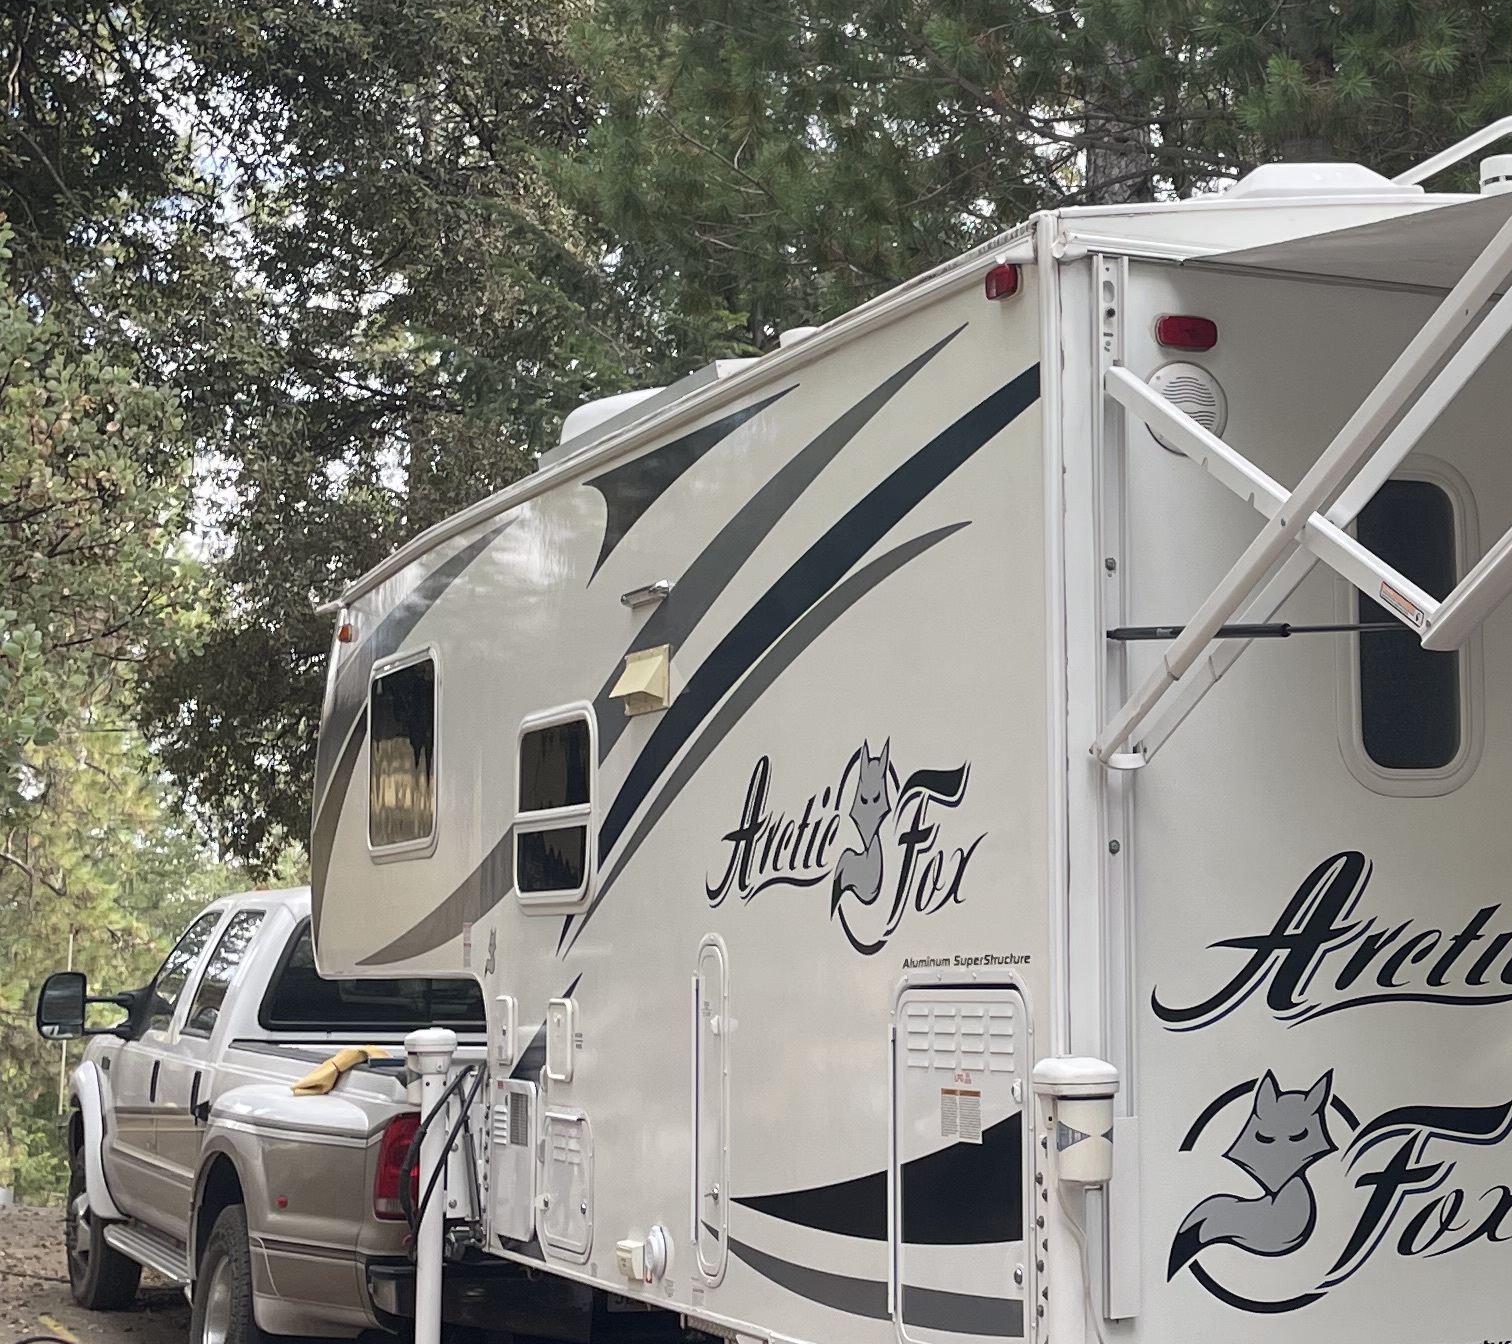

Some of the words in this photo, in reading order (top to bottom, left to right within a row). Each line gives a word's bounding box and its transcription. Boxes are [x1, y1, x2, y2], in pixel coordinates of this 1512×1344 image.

[705, 754, 841, 908] Arctic
[886, 760, 989, 937] Fox
[902, 956, 951, 969] Aluminum
